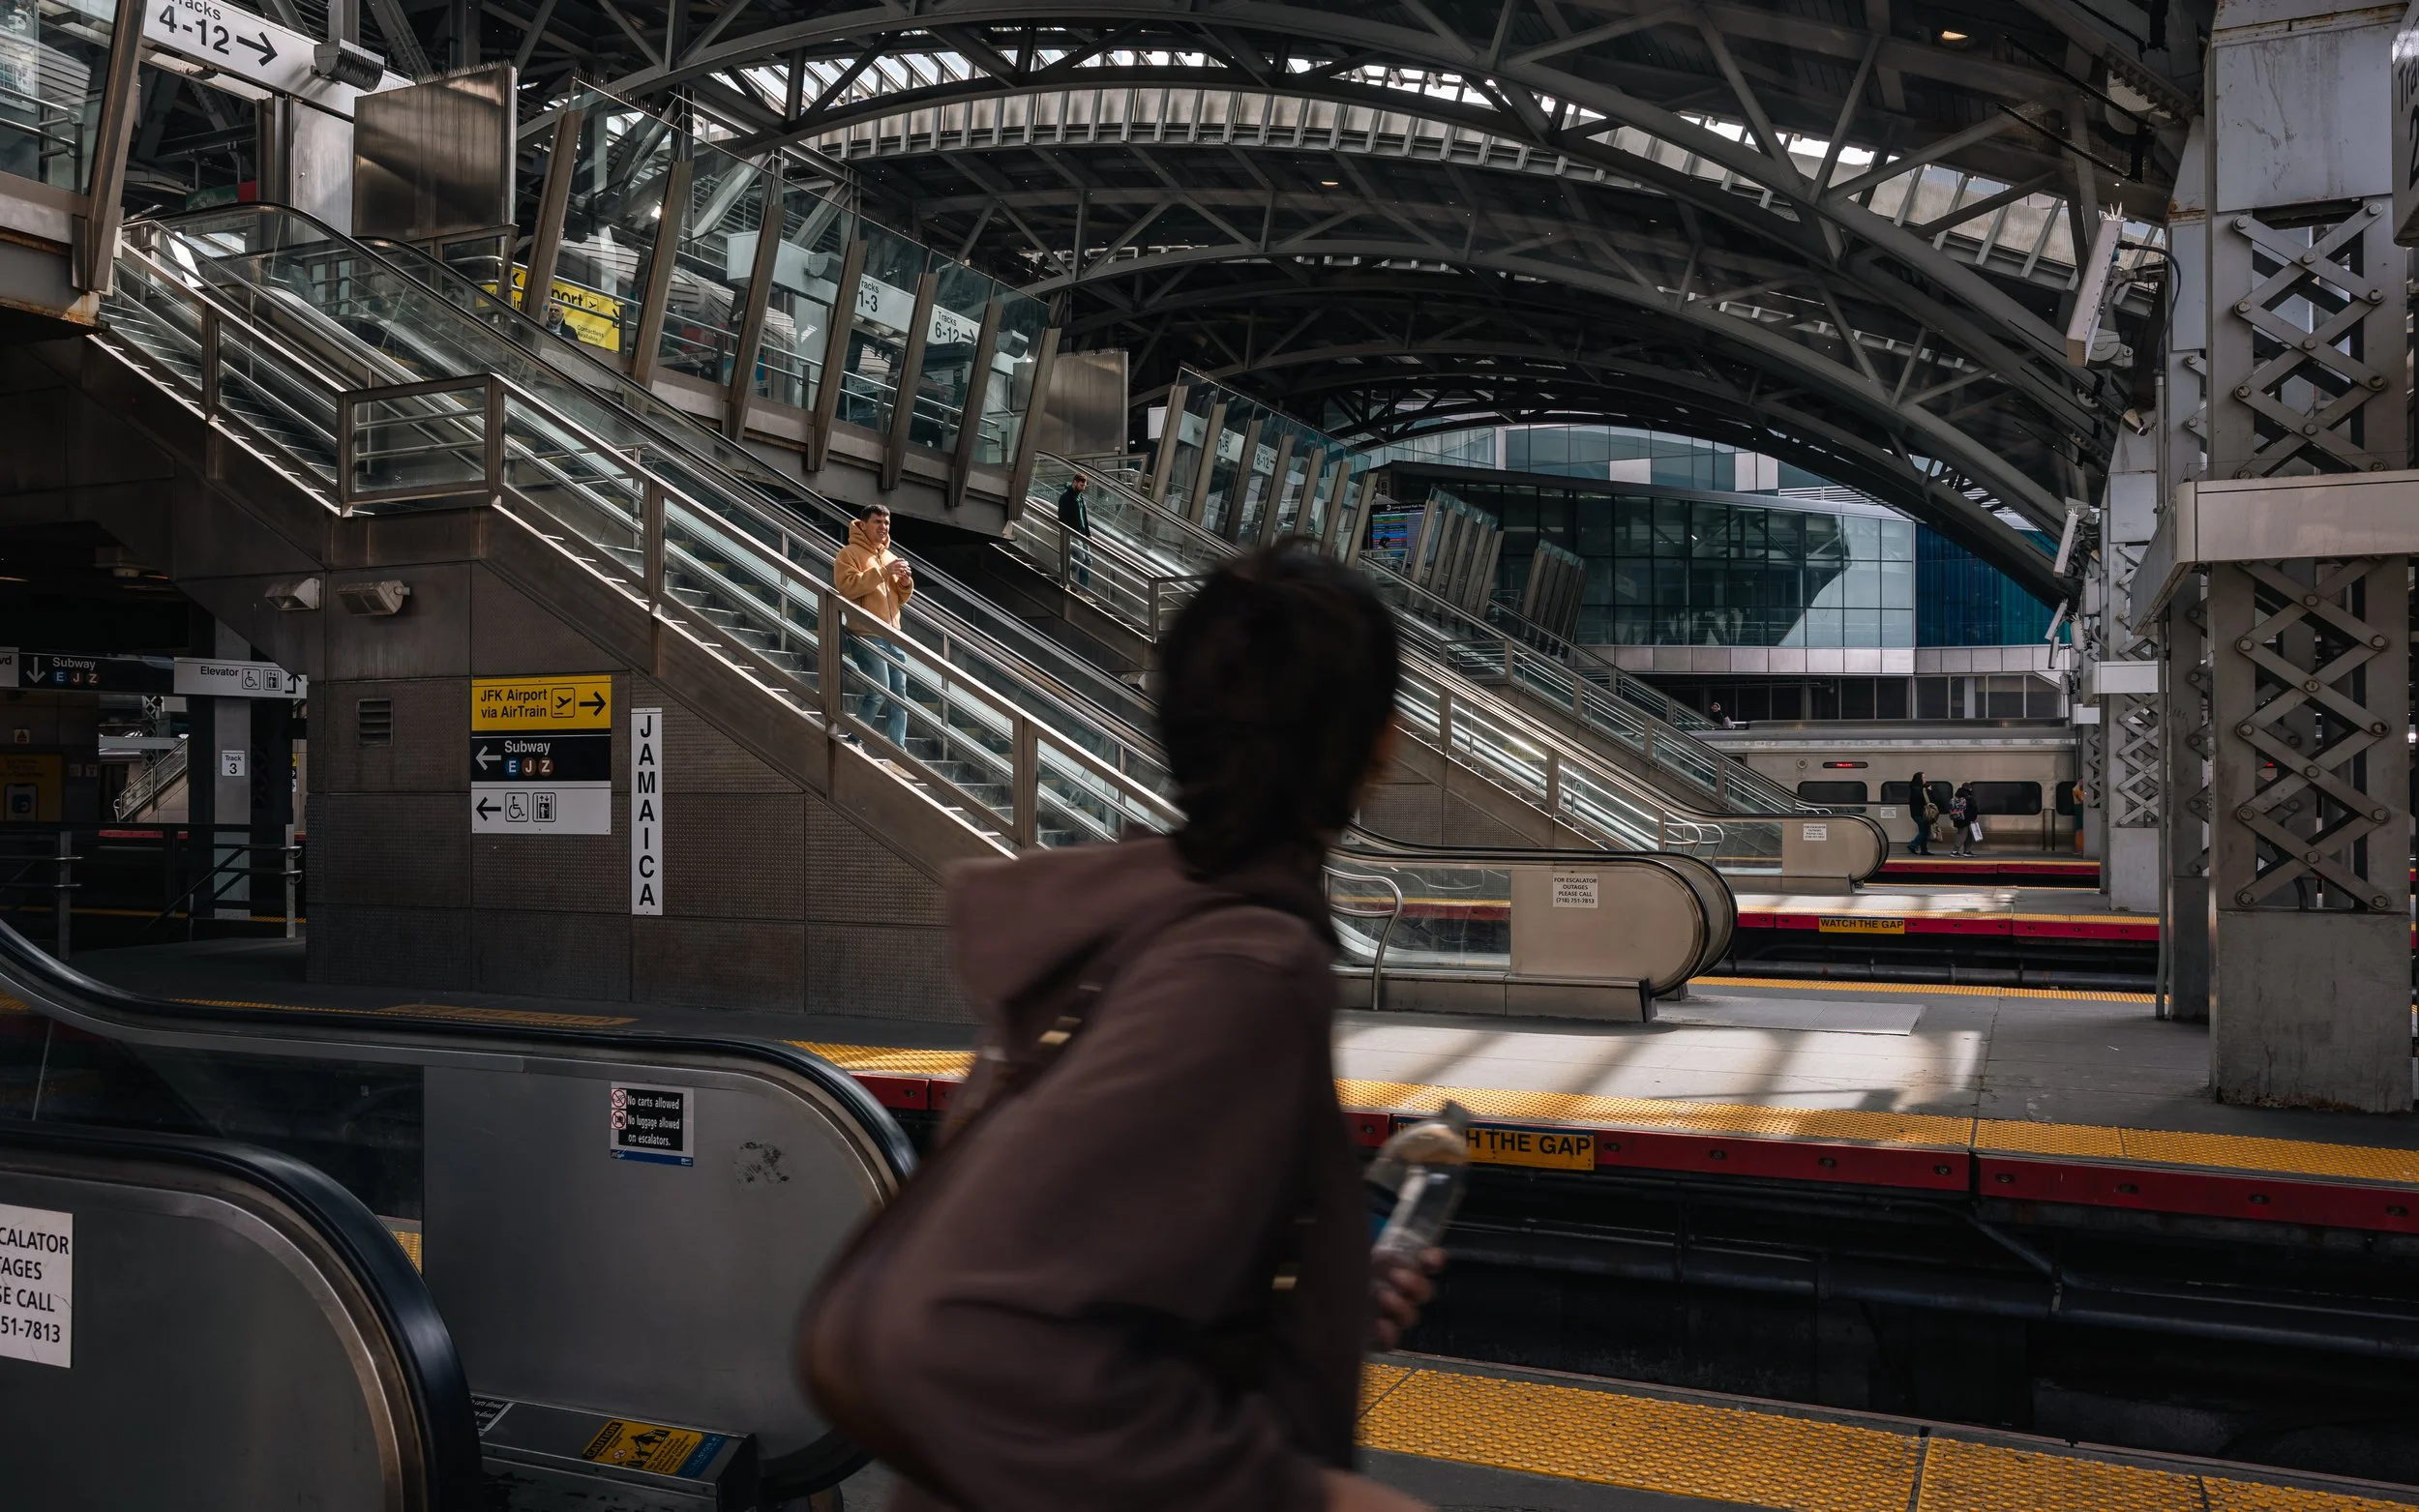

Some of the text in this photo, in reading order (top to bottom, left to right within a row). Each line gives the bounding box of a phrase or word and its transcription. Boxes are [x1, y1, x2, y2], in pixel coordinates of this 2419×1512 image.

[172, 0, 221, 20] racks
[160, 5, 229, 55] 4-12
[861, 281, 880, 293] racks
[858, 290, 878, 312] 1-3
[938, 311, 957, 326] Tracks
[935, 322, 959, 342] 6-12
[1257, 454, 1269, 469] 8-12
[52, 657, 96, 670] Subway
[56, 671, 98, 683] E J Z
[201, 666, 239, 677] Elevator
[481, 688, 548, 703] JFK Airport
[481, 705, 547, 719] via AirTrain
[504, 740, 551, 755] Subway
[229, 763, 237, 774] 3
[508, 760, 550, 773] E J Z
[638, 715, 656, 906] JAMAICA
[1820, 919, 1903, 929] WATCH THE GAP
[627, 1095, 679, 1110] No carts allowed
[627, 1114, 680, 1130] No luggage allowed
[628, 1134, 672, 1145] on escalators.
[1485, 1131, 1532, 1152] THE
[1538, 1135, 1591, 1156] GAP
[0, 1256, 42, 1280] AGES
[16, 1289, 55, 1313] CALL
[1, 1316, 61, 1343] 51-7813
[586, 1424, 620, 1457] CAUTION
